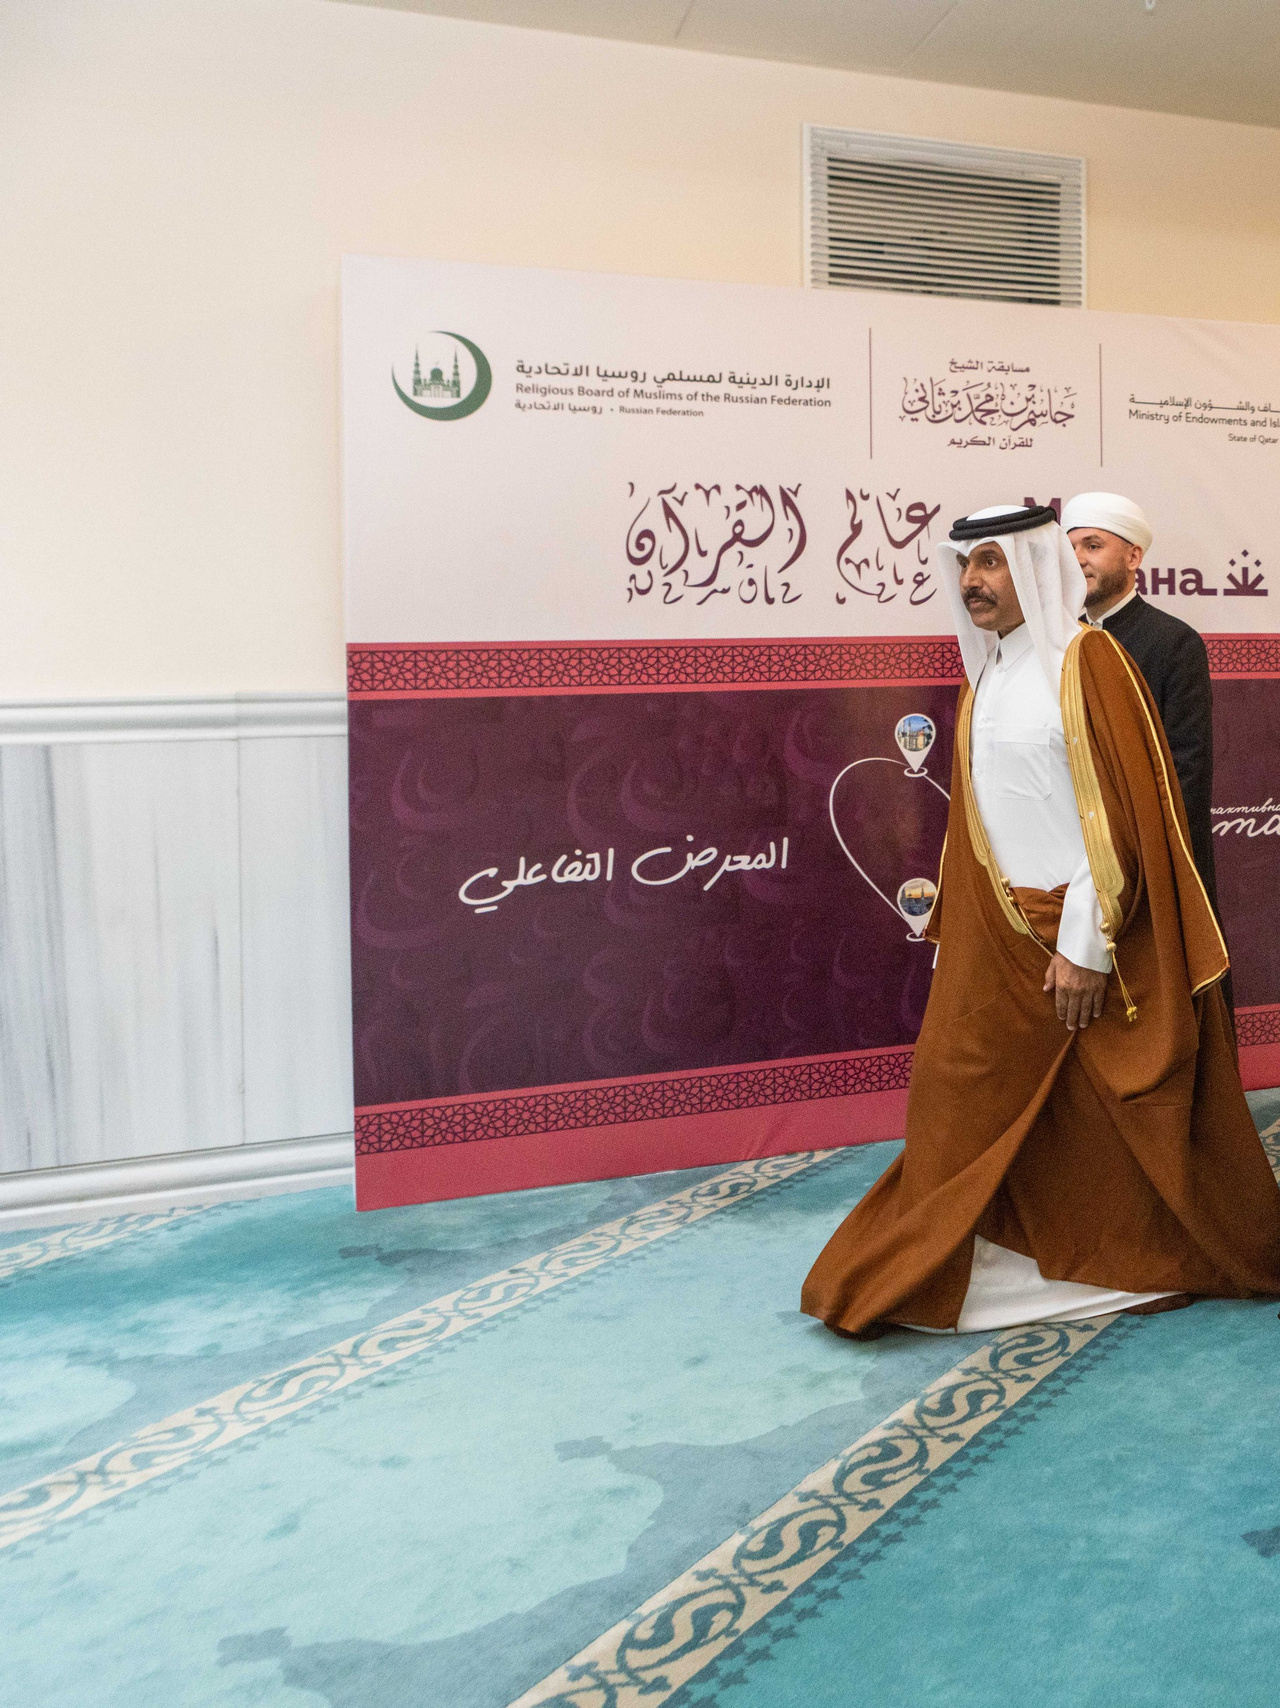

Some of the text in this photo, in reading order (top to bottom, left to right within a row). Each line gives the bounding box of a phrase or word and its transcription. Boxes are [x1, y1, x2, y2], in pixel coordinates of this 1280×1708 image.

[949, 358, 1030, 375] مسابقة الشيخ
[516, 360, 830, 393] الإدارة الدينية لمسلمي روسيا الاتحادية
[516, 383, 831, 407] Religious Board of Muslims of the Russian Federation
[515, 399, 603, 415] روسيا الاتحادية
[619, 406, 704, 417] Russian Federation
[1129, 409, 1169, 424] Ministry
[1172, 412, 1182, 422] of
[1185, 412, 1247, 426] Endowments
[1250, 417, 1267, 427] and
[947, 434, 1033, 450] للقرآن الكريم
[1228, 433, 1279, 445] State of Qatar
[458, 835, 788, 913] المعرض التفاعلي
